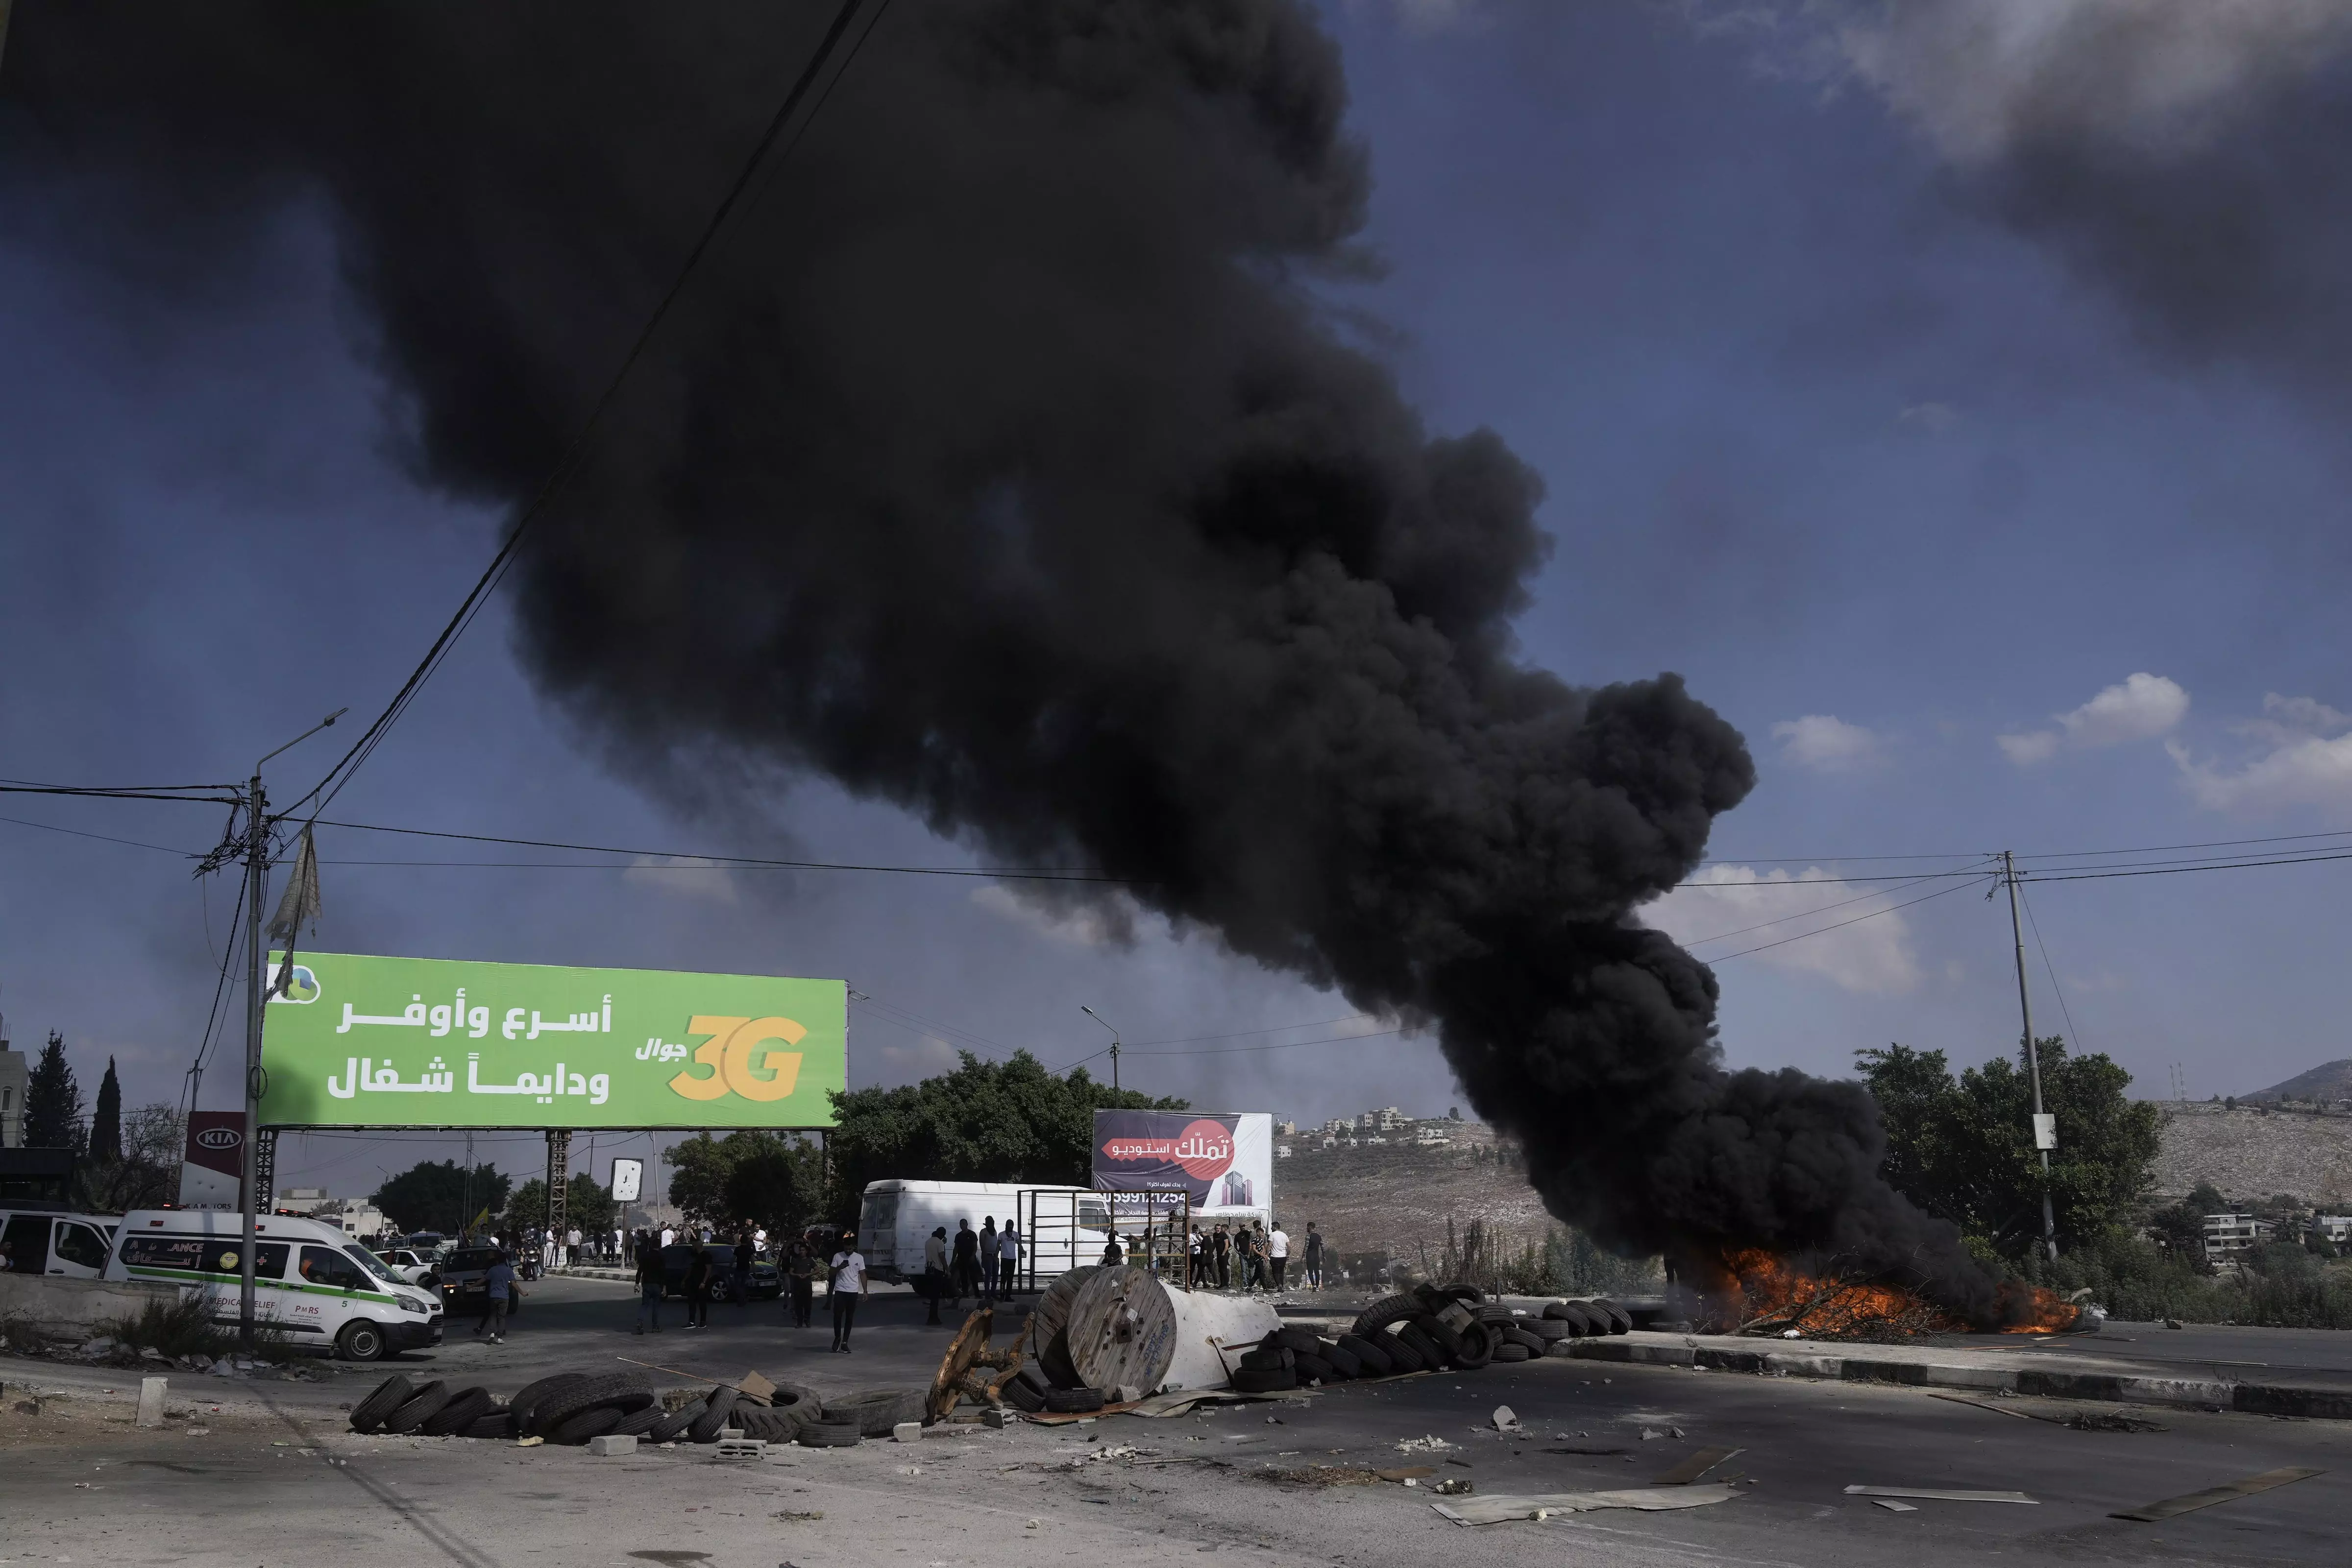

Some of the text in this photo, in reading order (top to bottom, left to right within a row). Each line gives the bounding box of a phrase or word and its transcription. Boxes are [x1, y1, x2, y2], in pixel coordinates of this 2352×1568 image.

[335, 987, 612, 1040] أسرع وأوفر
[635, 1037, 688, 1062] جوال
[668, 1015, 808, 1102] 3G
[327, 1056, 454, 1099] شغال
[205, 1133, 235, 1144] KIA
[1112, 1142, 1170, 1156] استوديو
[129, 1240, 204, 1253] AANCE
[209, 1297, 276, 1309] MEDICA ELIEF
